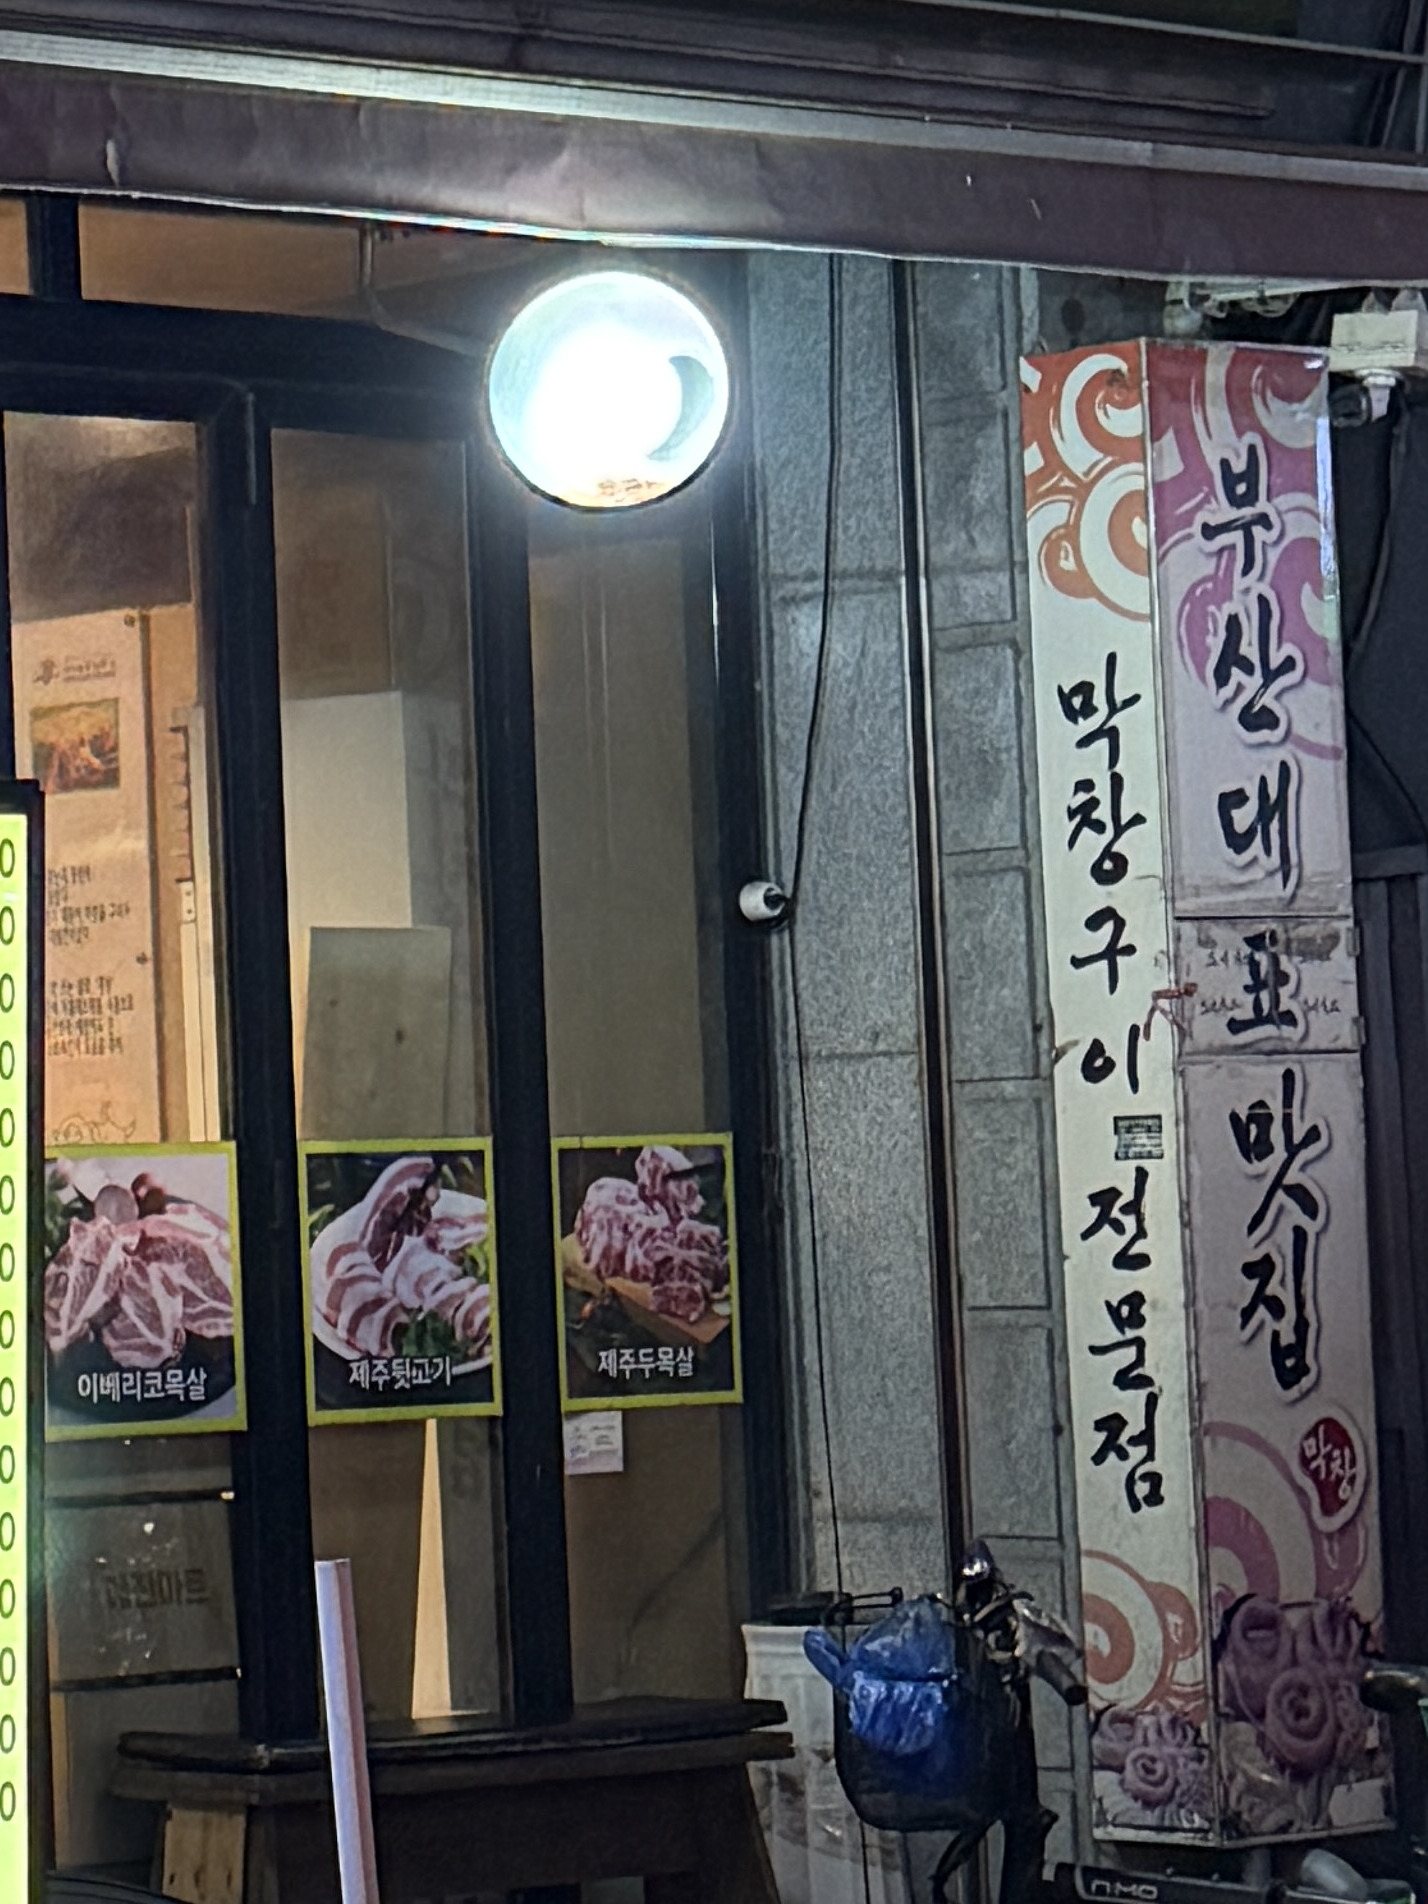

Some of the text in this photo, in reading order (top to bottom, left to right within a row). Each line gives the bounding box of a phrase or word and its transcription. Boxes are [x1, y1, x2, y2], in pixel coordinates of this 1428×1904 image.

[1081, 1166, 1165, 1514] 전문점
[348, 1354, 454, 1393] 제주뒷고기
[597, 1345, 696, 1380] 제주두목살
[76, 1369, 208, 1405] 이베리코목살
